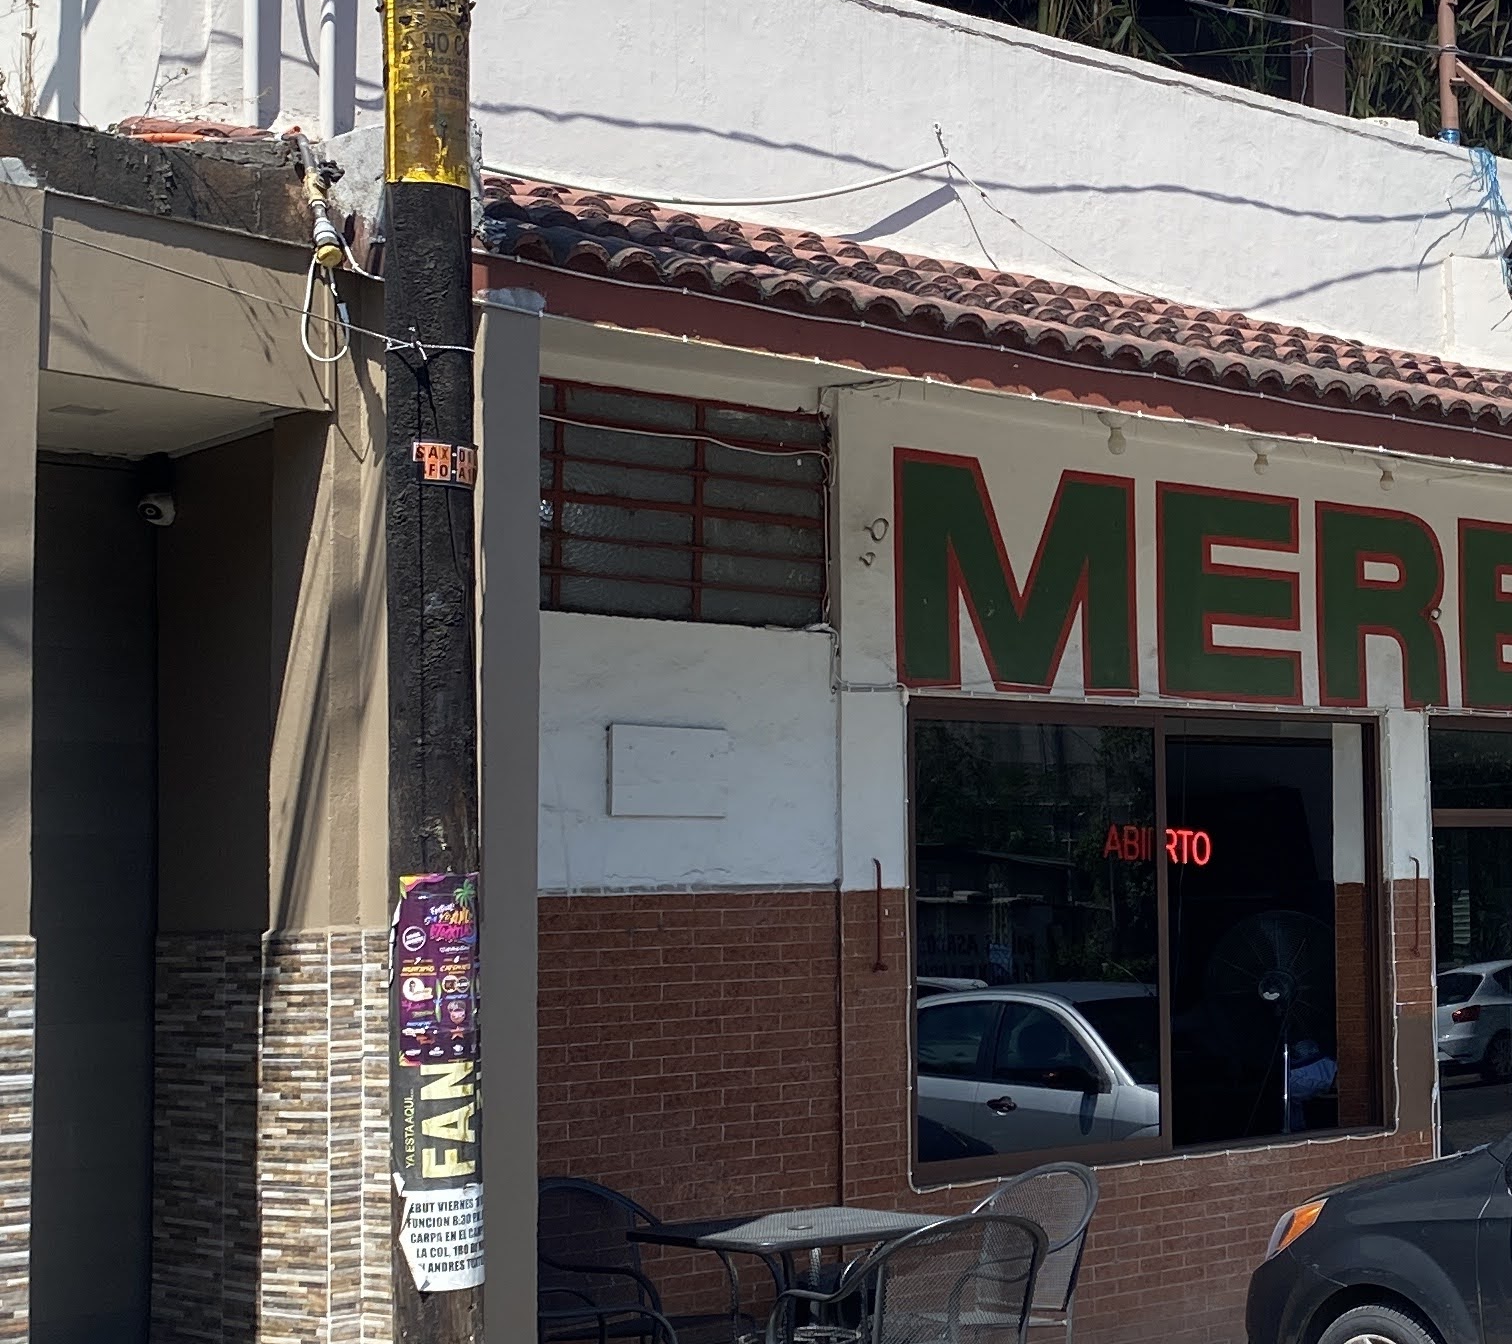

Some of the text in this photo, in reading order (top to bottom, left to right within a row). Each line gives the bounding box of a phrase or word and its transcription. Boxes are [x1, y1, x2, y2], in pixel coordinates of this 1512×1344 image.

[405, 1154, 415, 1169] YA
[409, 1202, 435, 1213] EBUT
[438, 1198, 474, 1212] VIERNES
[407, 1216, 450, 1229] FUNCION
[410, 1232, 443, 1244] CARPA
[445, 1230, 457, 1242] EN
[416, 1247, 428, 1259] LA
[428, 1259, 465, 1273] ANDRES
